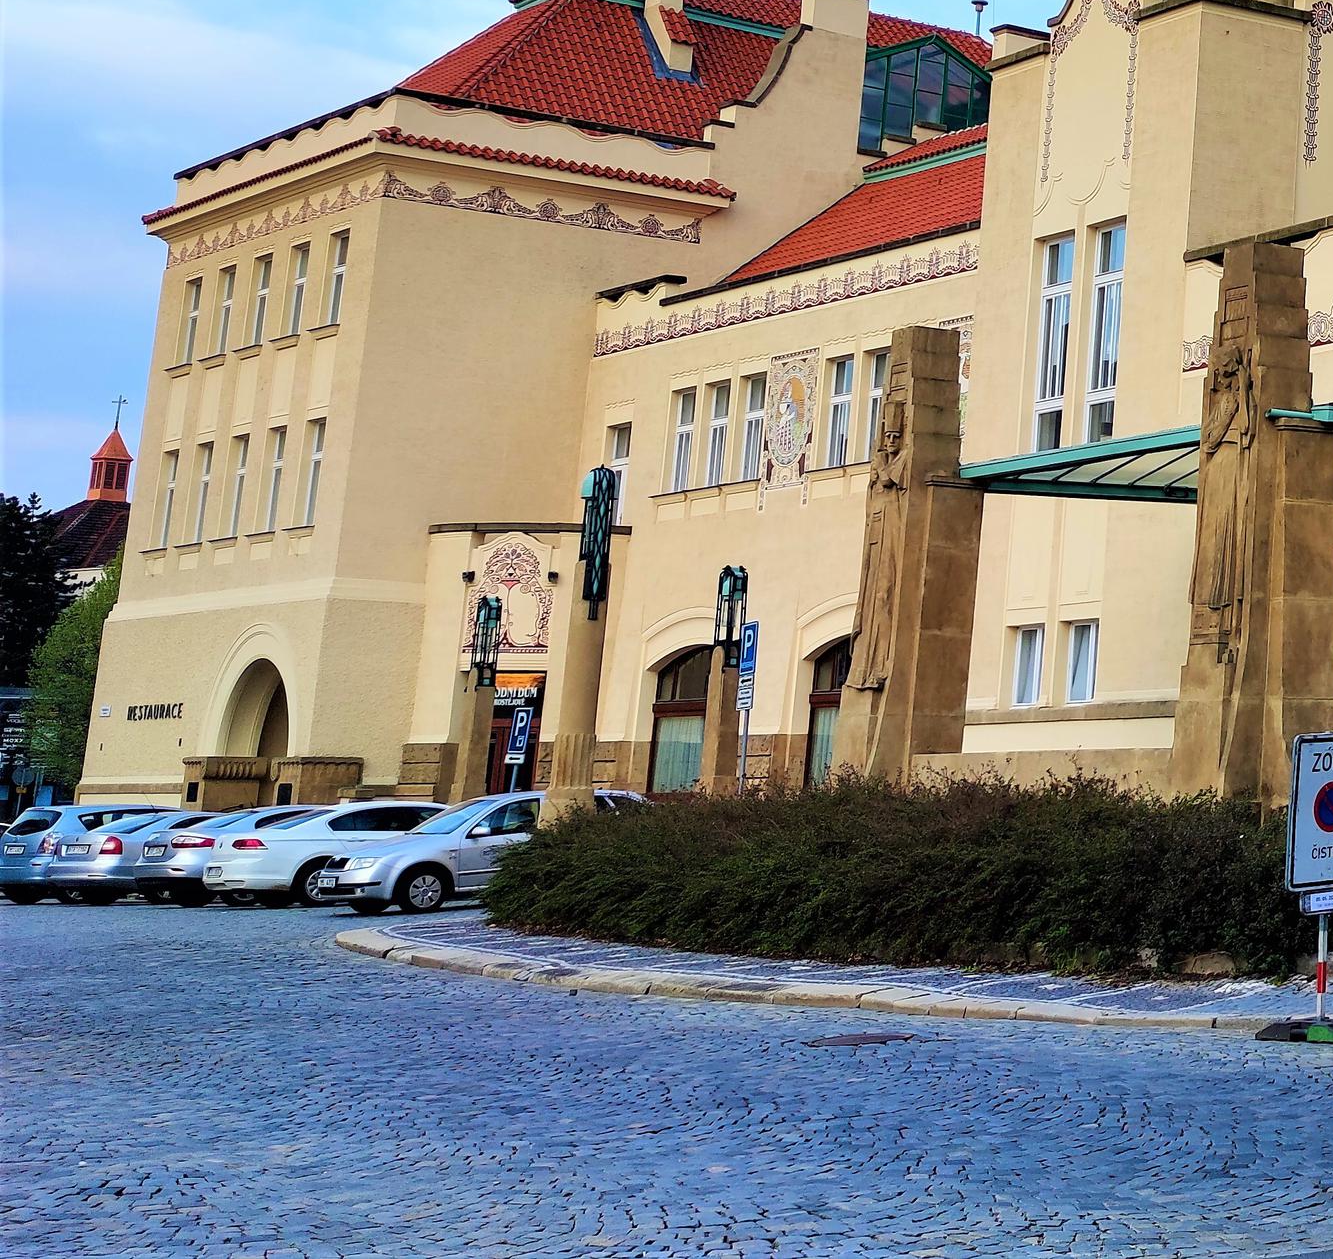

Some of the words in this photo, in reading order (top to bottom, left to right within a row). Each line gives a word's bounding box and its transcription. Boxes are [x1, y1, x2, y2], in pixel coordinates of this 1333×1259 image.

[743, 629, 753, 658] P
[127, 703, 183, 721] RESTAURACE
[514, 712, 527, 736] P
